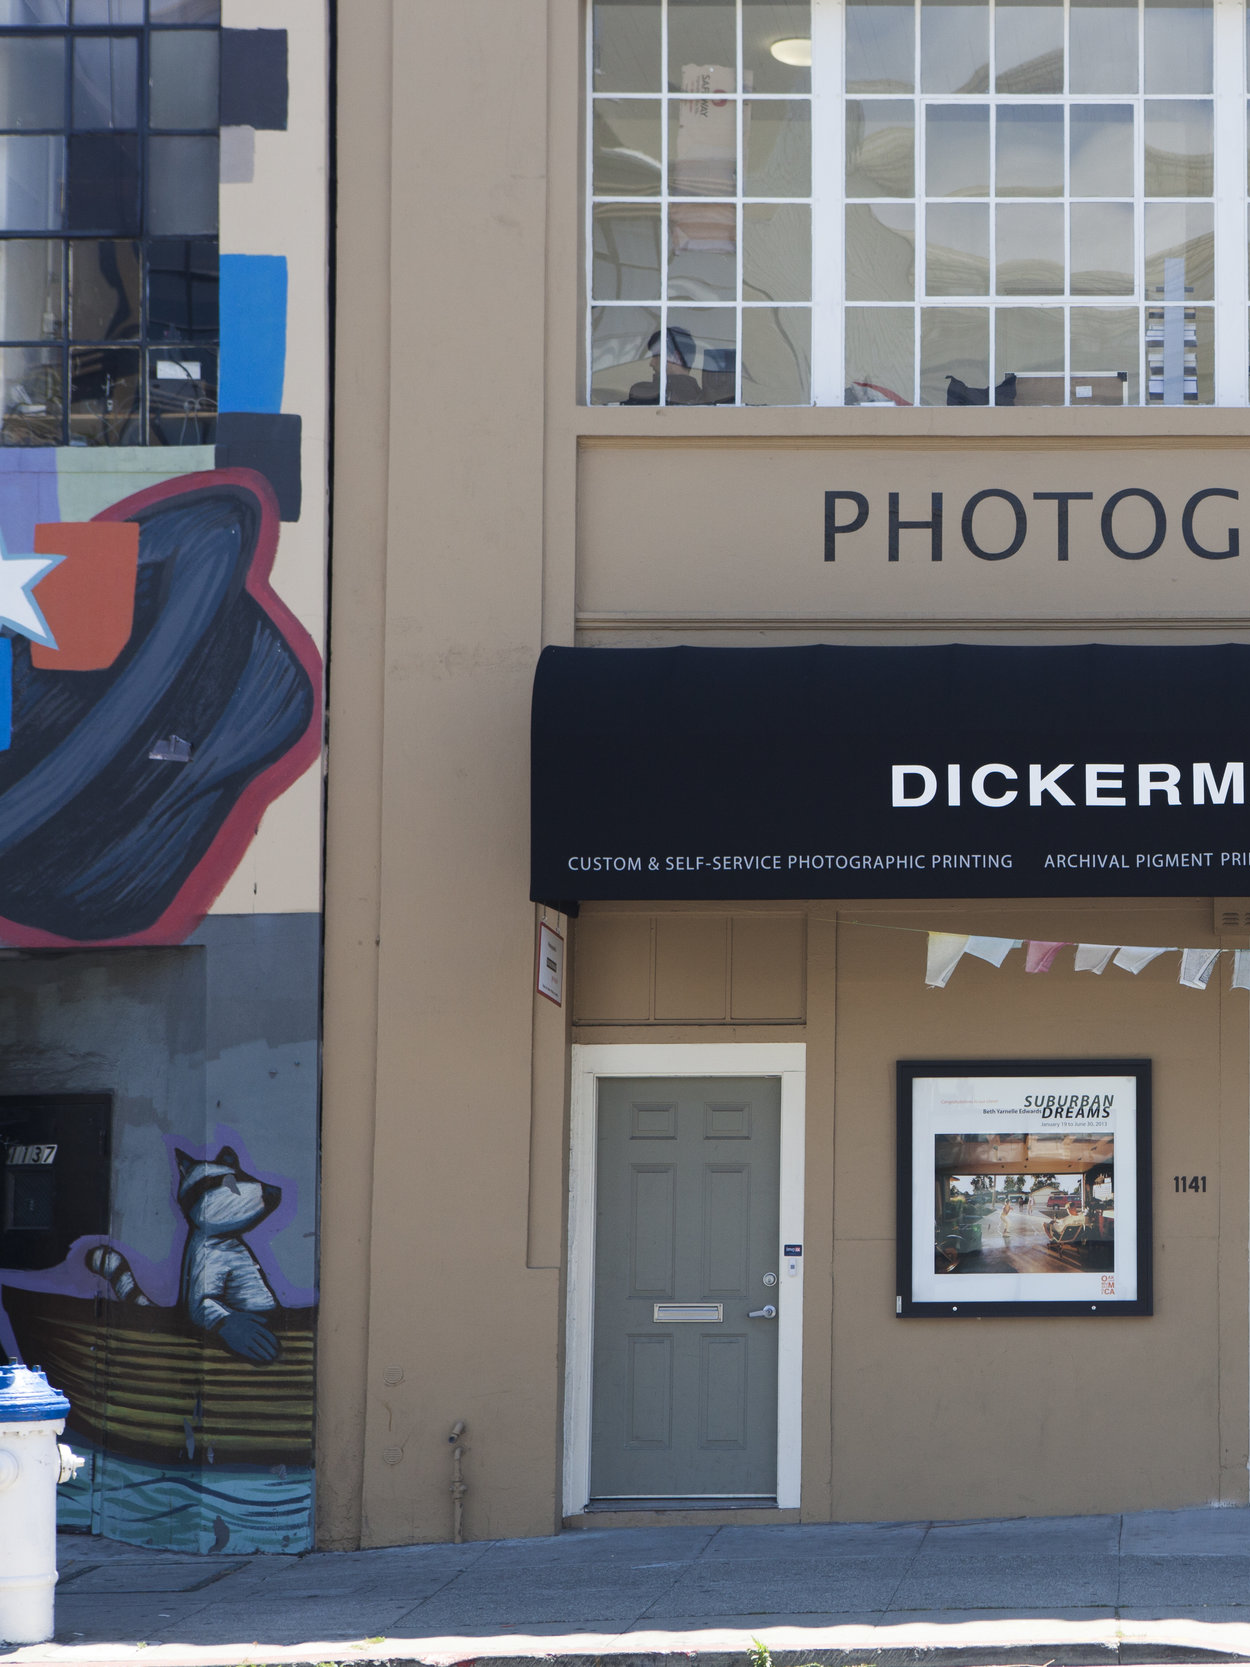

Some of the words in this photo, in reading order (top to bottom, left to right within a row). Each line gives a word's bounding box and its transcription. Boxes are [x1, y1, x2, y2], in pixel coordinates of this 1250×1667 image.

[567, 856, 642, 871] CUSTOM
[647, 856, 660, 871] &
[665, 855, 782, 871] SELF-SERVICE
[788, 854, 926, 870] PHOTOGRAPHIC
[931, 854, 1013, 869] PRINTING
[1044, 853, 1130, 869] ARCHIVAL
[1136, 852, 1214, 868] PIGMENT
[1024, 1094, 1114, 1108] SUBURBAN
[1041, 1106, 1111, 1119] DREAMS
[10, 1145, 57, 1164] 1137
[1173, 1175, 1207, 1193] 1141
